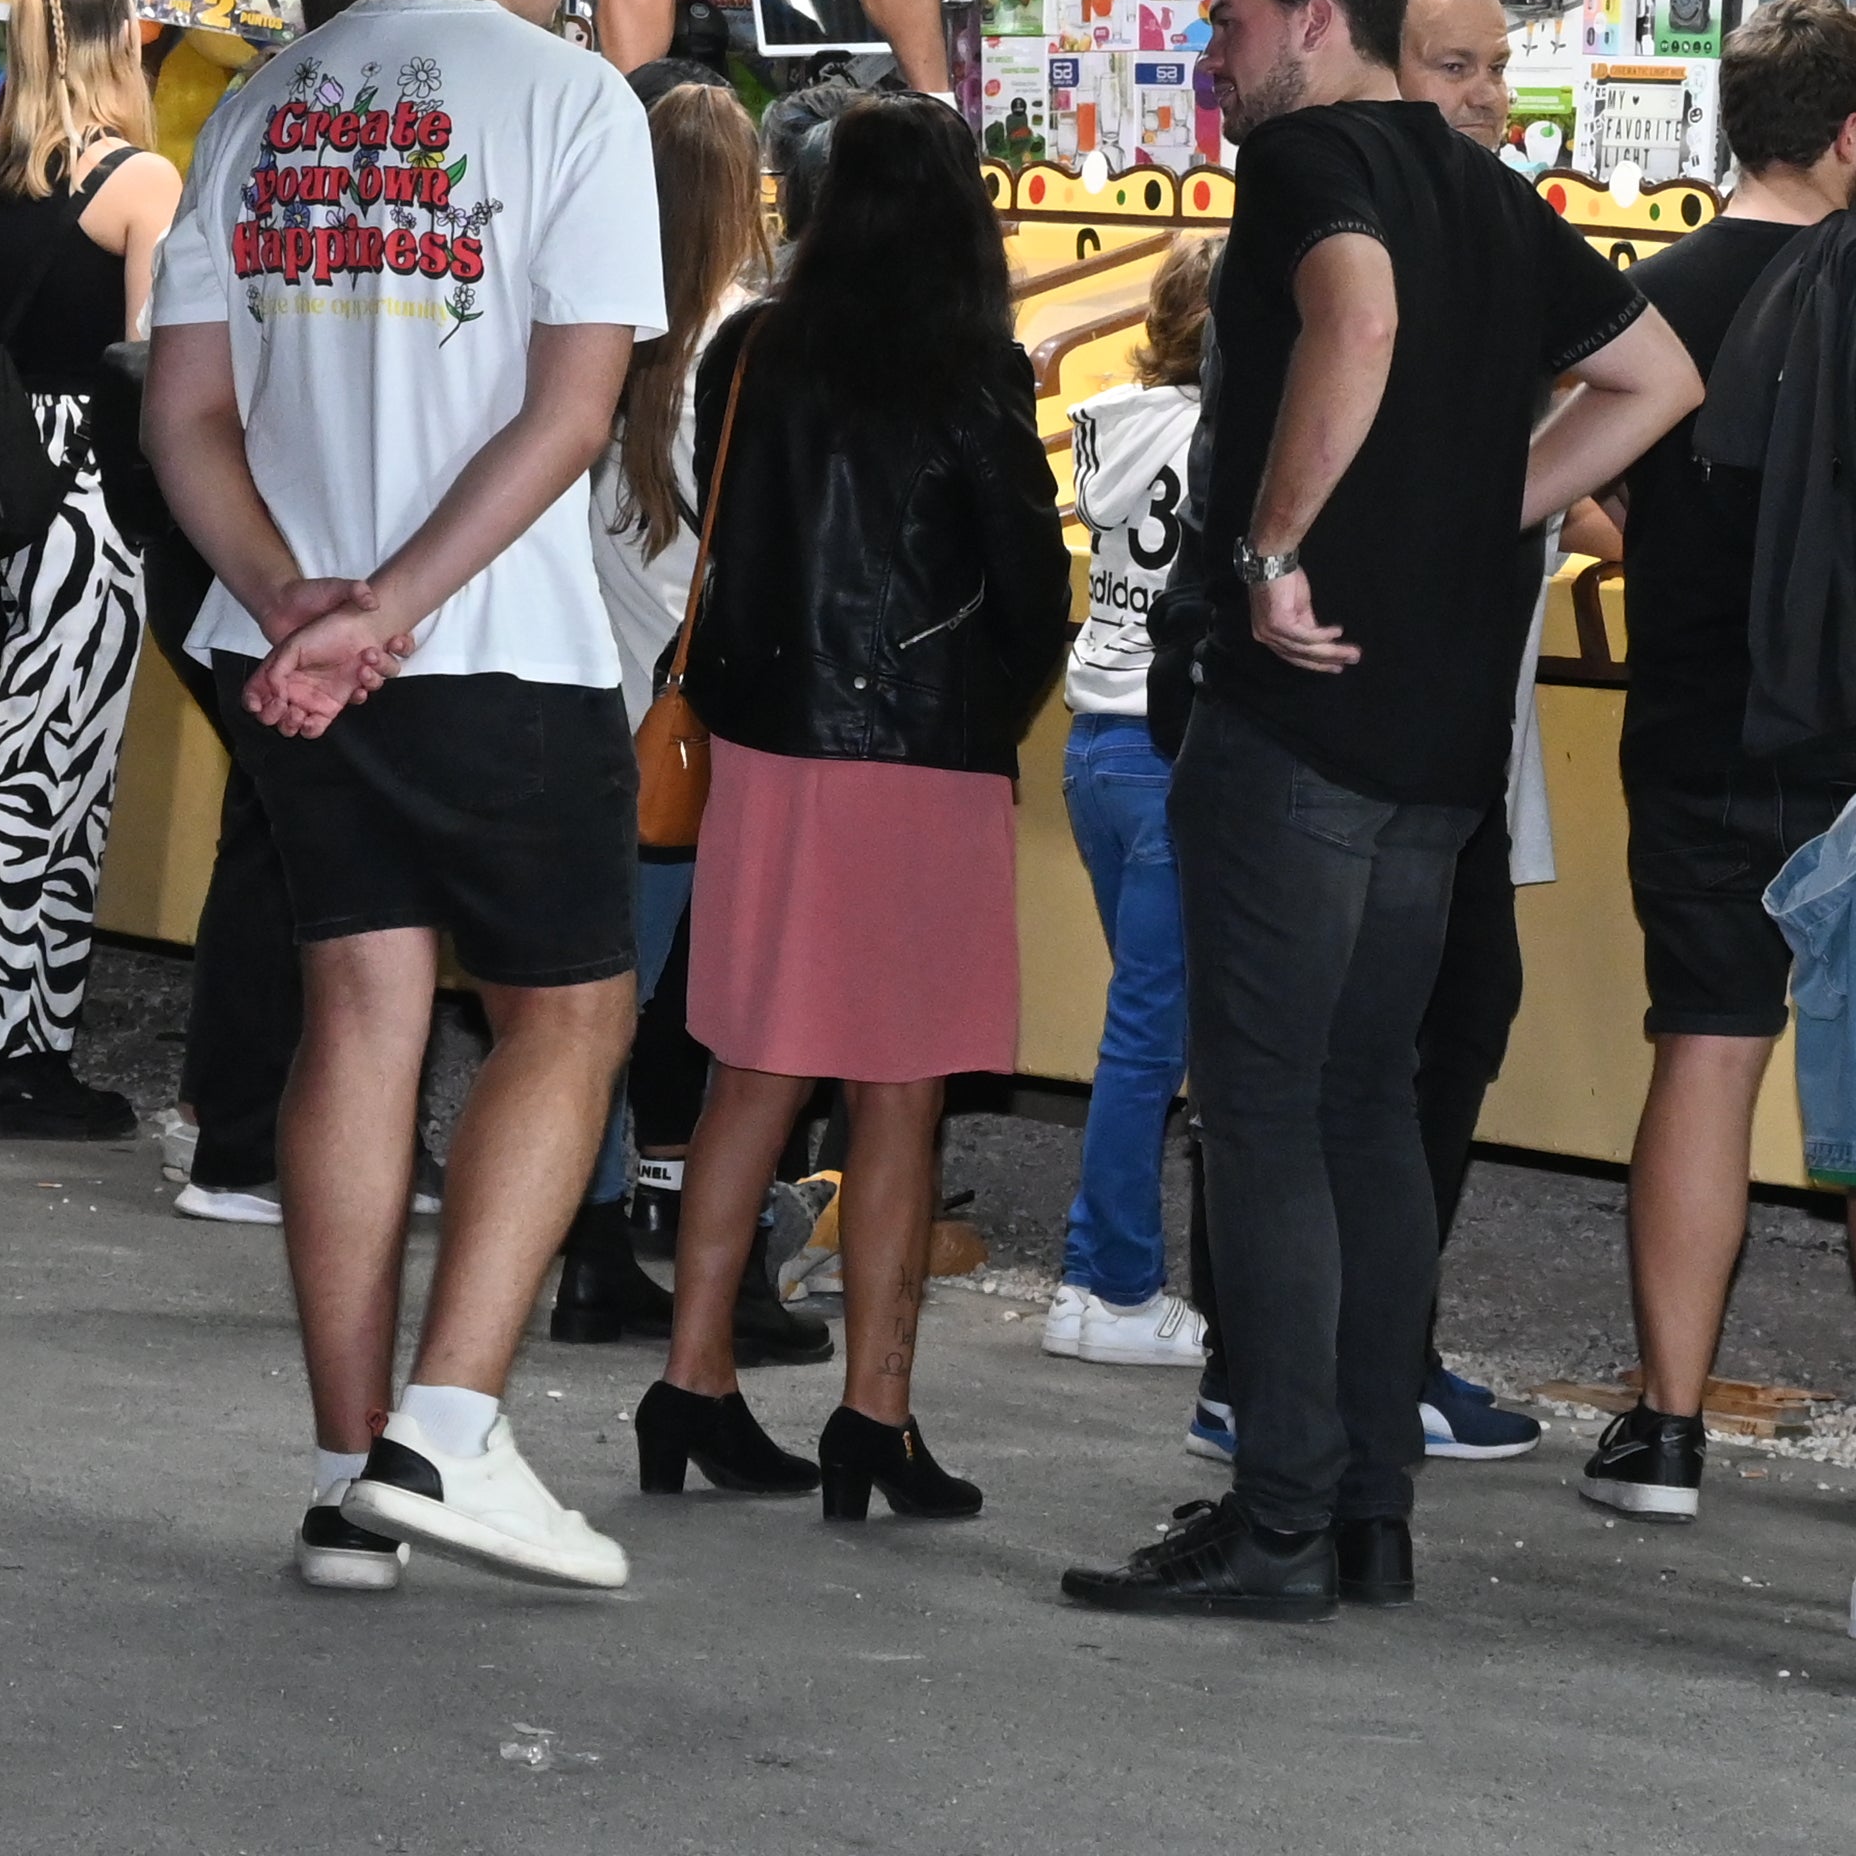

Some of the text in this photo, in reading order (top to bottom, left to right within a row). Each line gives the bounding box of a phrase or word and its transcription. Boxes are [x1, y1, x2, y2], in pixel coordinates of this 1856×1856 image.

[268, 100, 452, 153] Create
[1607, 90, 1626, 110] MY
[1605, 119, 1682, 142] FAVORITE
[254, 160, 452, 220] your own
[232, 211, 484, 291] Happiness
[1091, 464, 1182, 570] 3
[1089, 570, 1164, 615] dida
